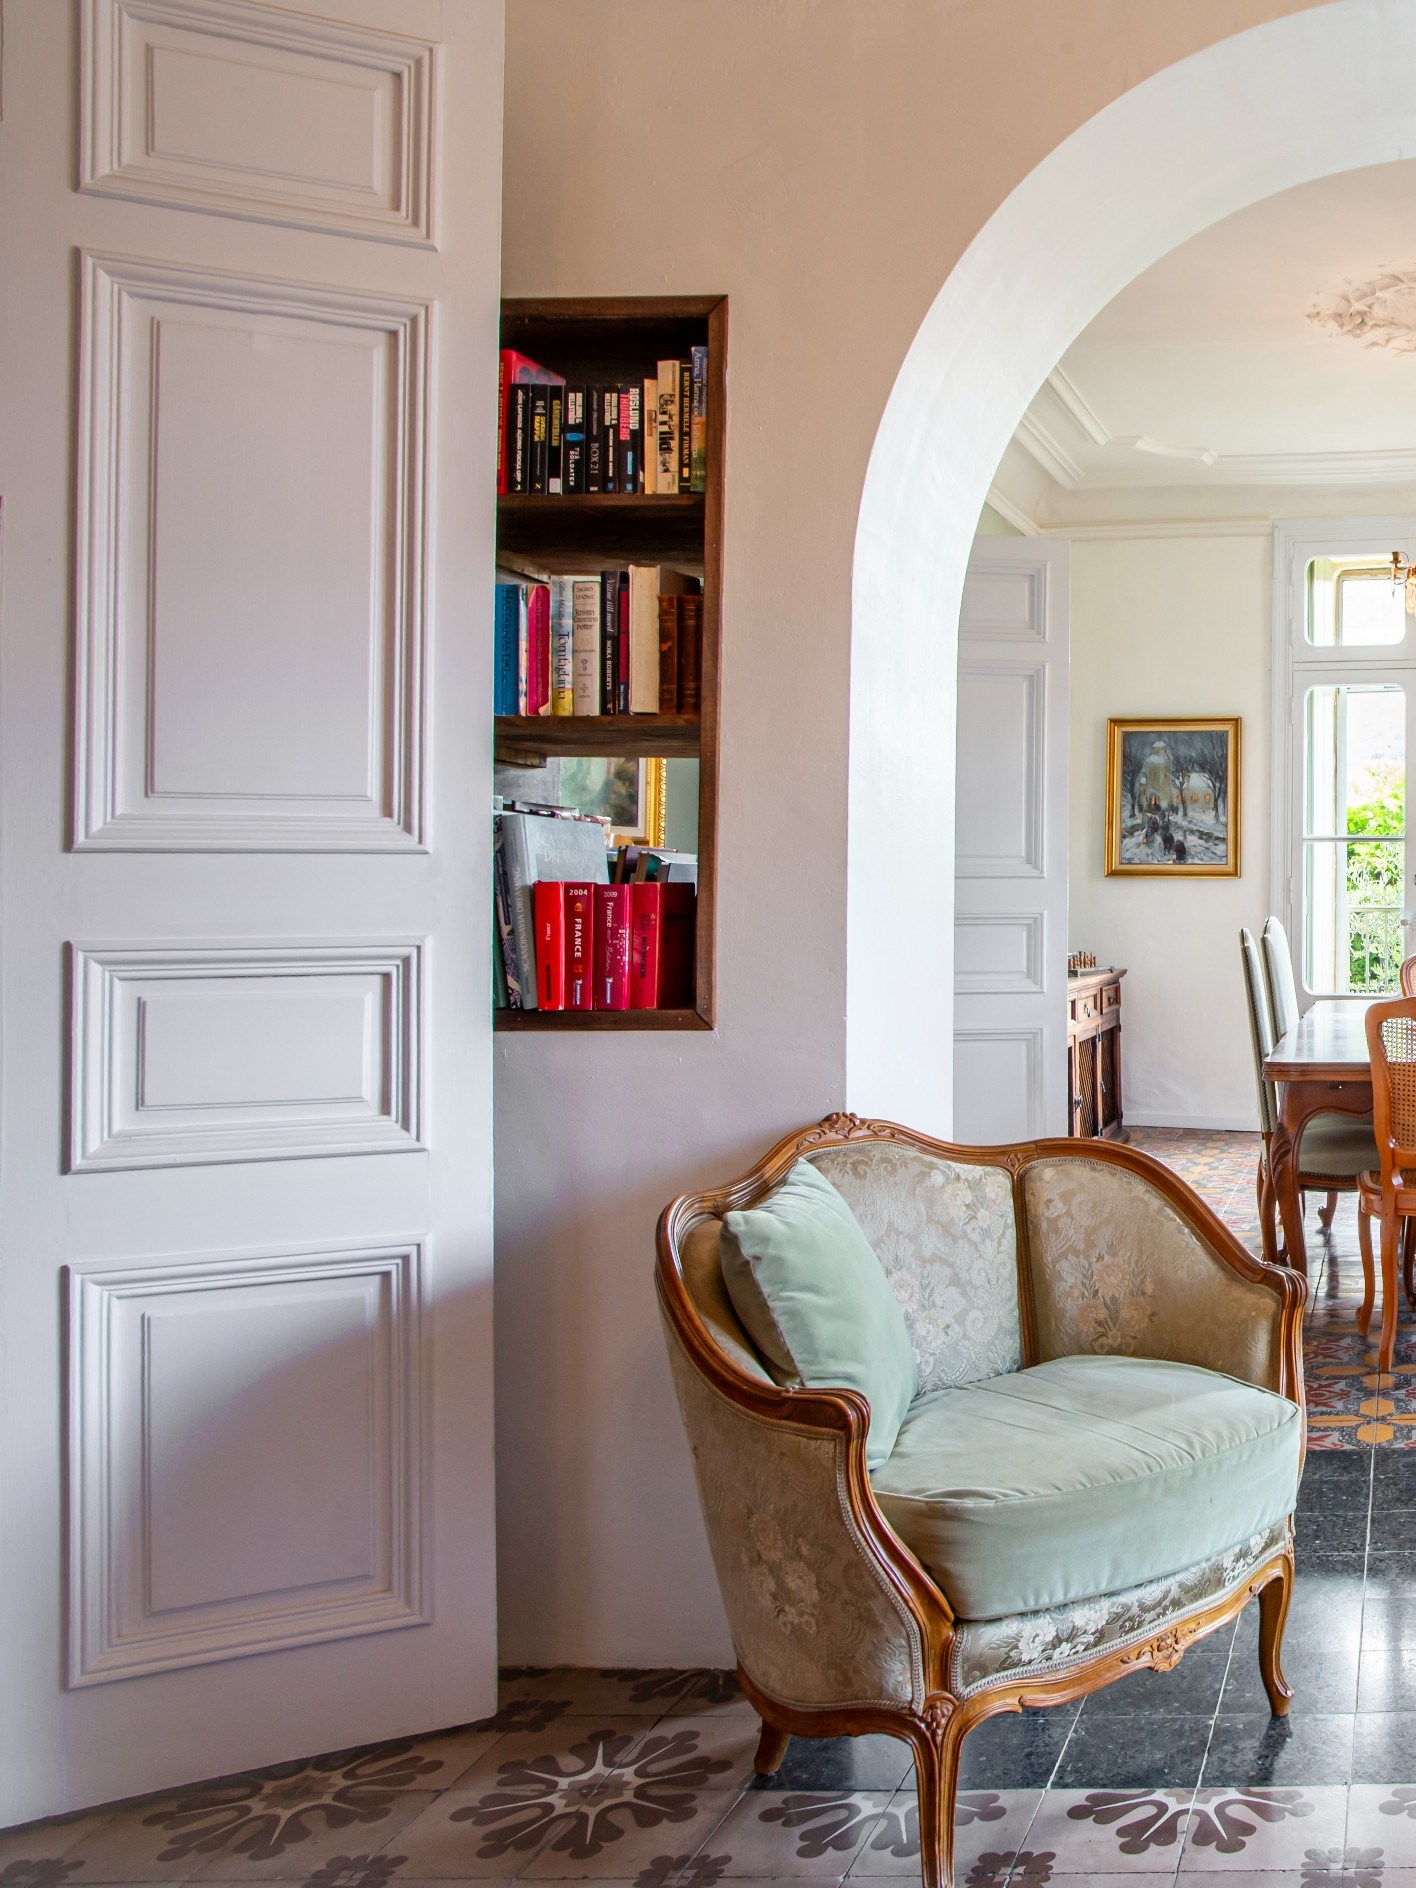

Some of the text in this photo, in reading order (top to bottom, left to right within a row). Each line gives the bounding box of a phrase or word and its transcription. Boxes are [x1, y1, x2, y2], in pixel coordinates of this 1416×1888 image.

[620, 393, 630, 441] THUNBERG
[630, 388, 640, 430] ROSLUND
[590, 443, 599, 464] BOX
[512, 866, 530, 972] SCANDINAVIA DREAMING
